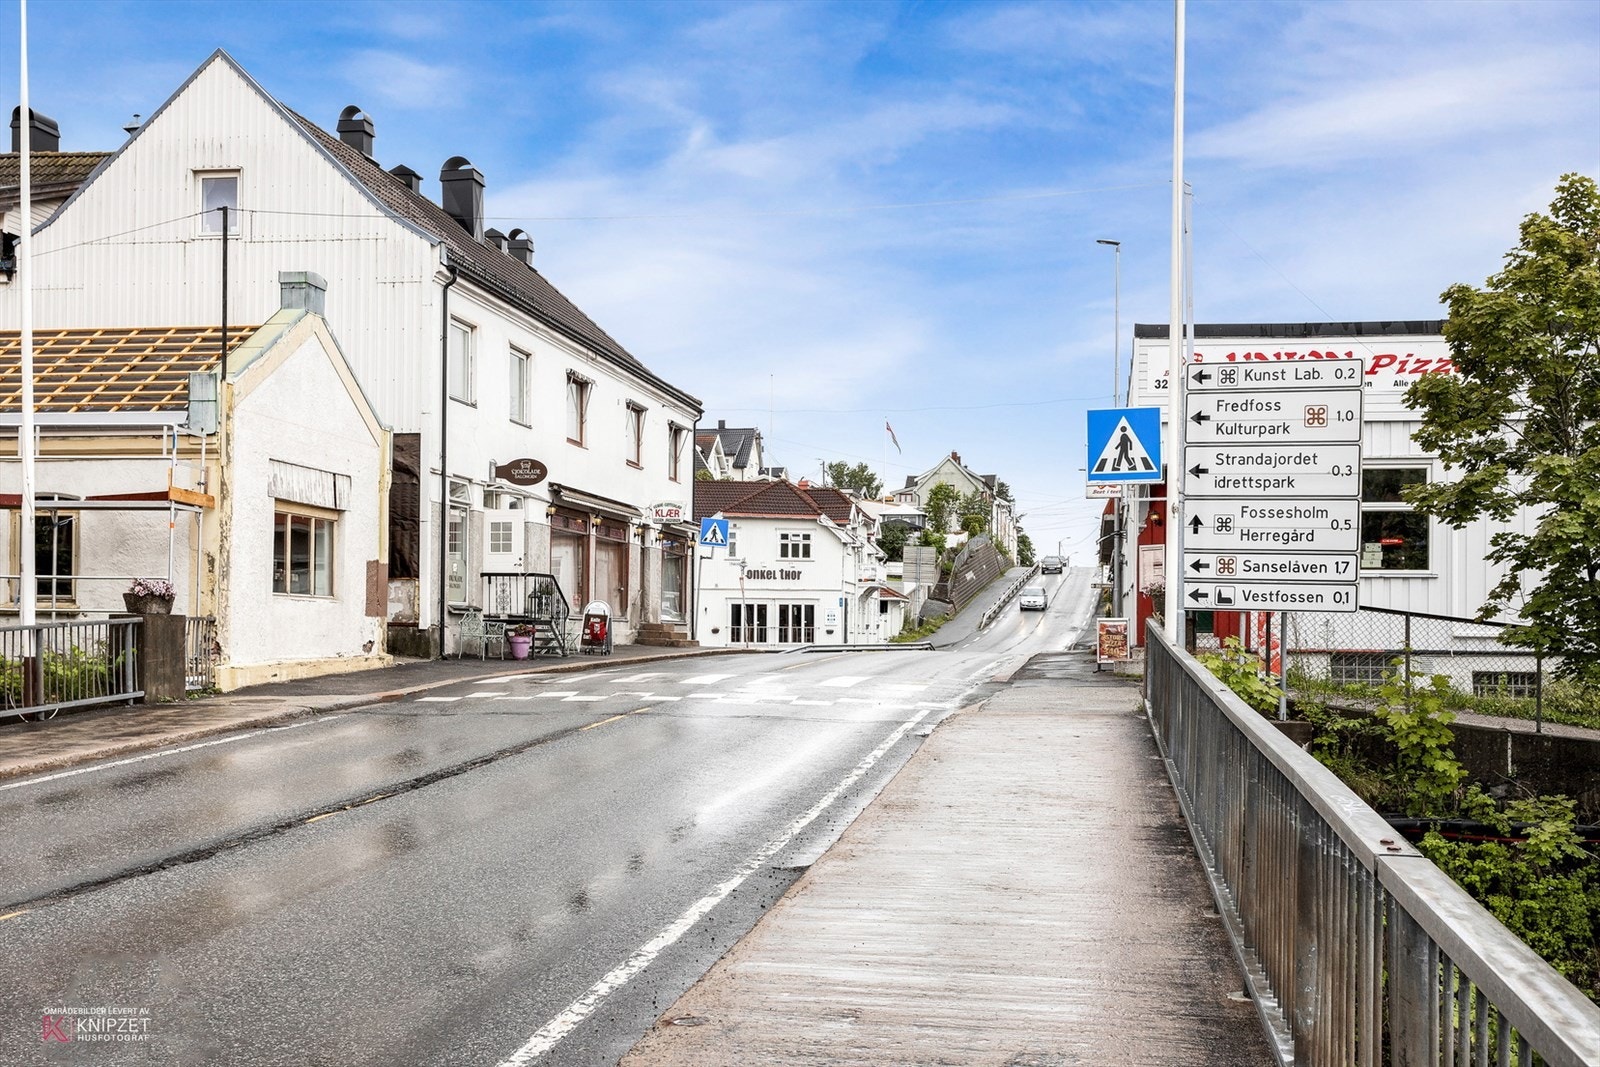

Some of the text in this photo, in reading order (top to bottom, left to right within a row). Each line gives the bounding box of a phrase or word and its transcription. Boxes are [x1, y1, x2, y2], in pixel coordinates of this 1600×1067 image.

[1365, 353, 1460, 375] Pizz
[1244, 367, 1356, 382] Kunst Lab. 0,2
[1393, 379, 1409, 388] Alle
[1216, 398, 1281, 413] Fredfoss
[1336, 409, 1354, 422] 1,0
[1215, 421, 1291, 438] Kulturpark
[1215, 452, 1318, 469] Strandajordet
[1331, 464, 1353, 477] 0,3
[1214, 475, 1295, 492] idrettspark
[655, 508, 680, 518] KLÆR
[1240, 505, 1329, 519] Fossesholm
[1330, 518, 1352, 531] 0,5
[1240, 528, 1315, 545] Herregård
[1242, 560, 1328, 574] Sanselåven
[1242, 589, 1350, 605] Vestfossen 0,1
